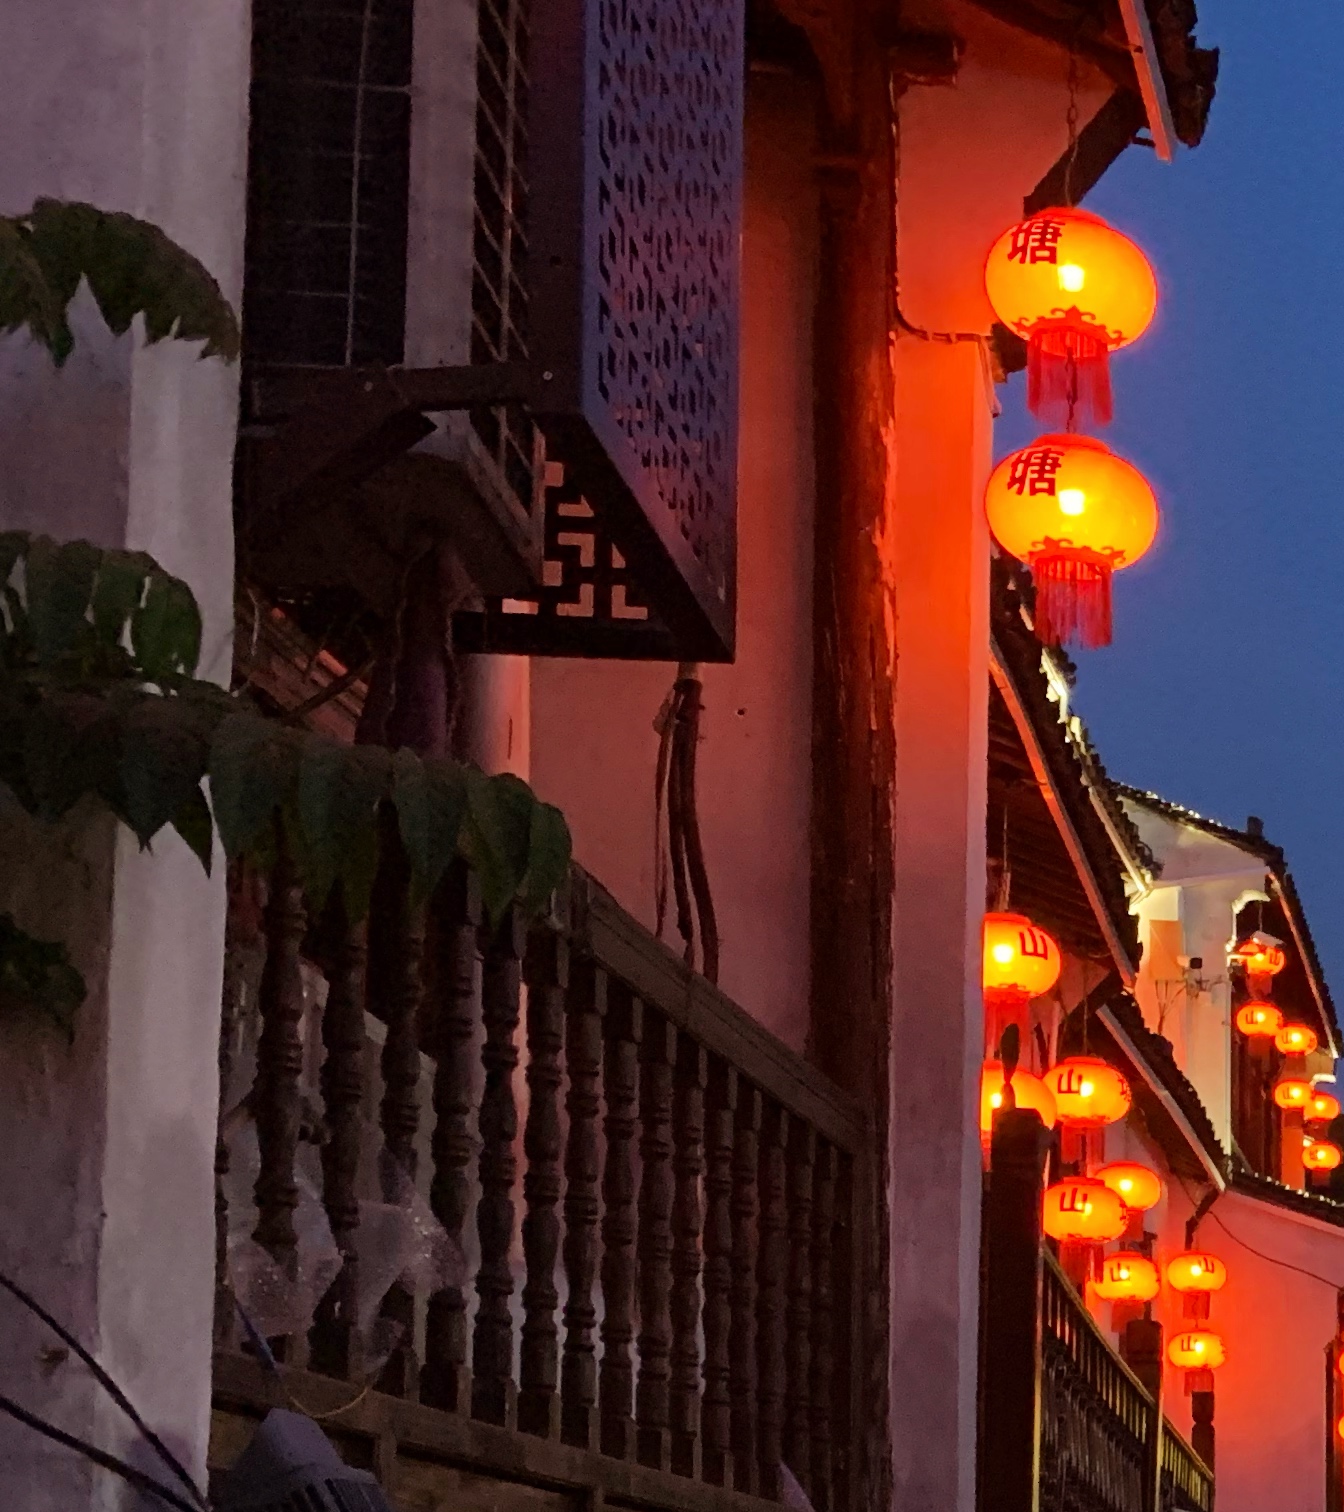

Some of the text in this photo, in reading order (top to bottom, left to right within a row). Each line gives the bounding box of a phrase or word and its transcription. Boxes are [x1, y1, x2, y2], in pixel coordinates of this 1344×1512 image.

[1007, 219, 1065, 265] 塘
[1007, 447, 1064, 496] 塘
[1019, 927, 1048, 960] 山
[1057, 1068, 1083, 1095] 山
[1060, 1187, 1089, 1213] 山
